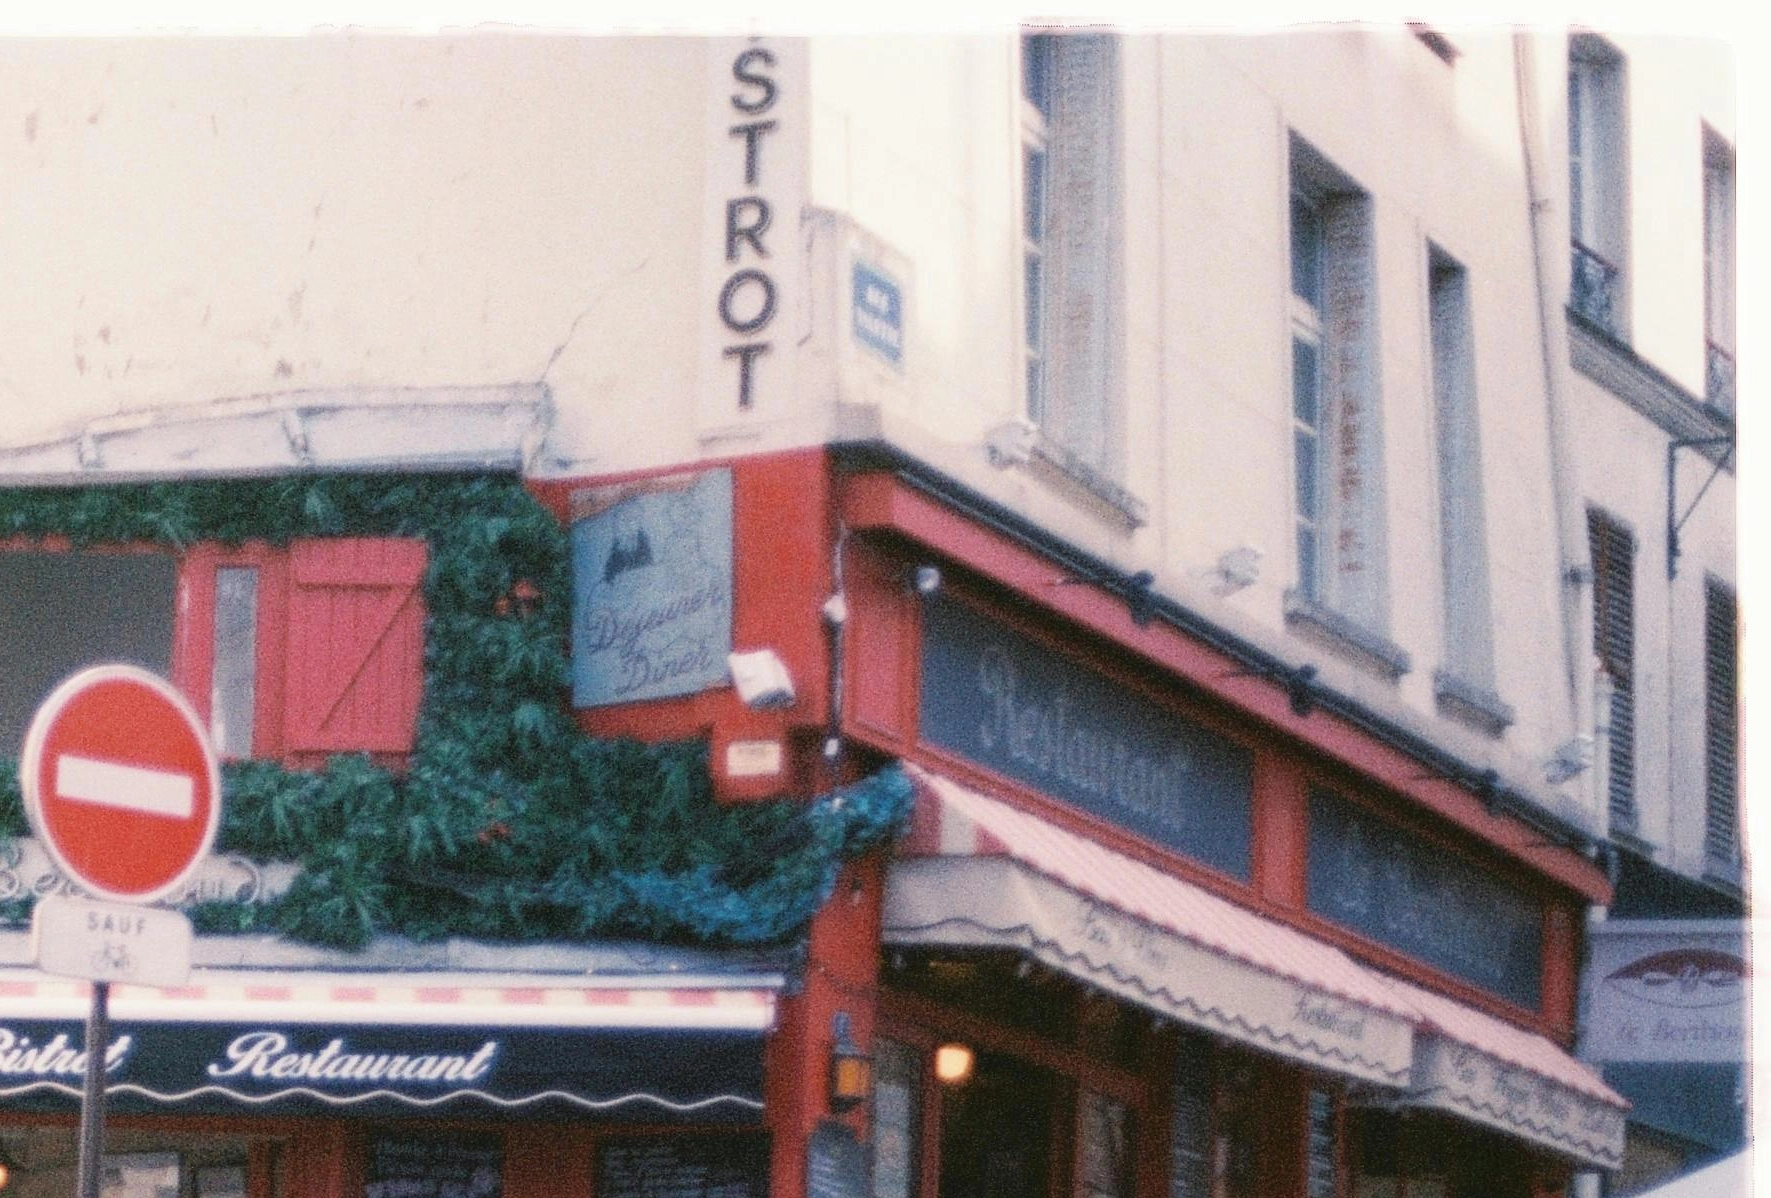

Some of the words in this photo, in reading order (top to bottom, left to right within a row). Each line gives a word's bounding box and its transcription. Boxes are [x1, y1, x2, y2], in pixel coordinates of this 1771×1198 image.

[718, 36, 777, 411] STROT
[88, 911, 146, 934] SAUF
[208, 1031, 496, 1081] Restaurant
